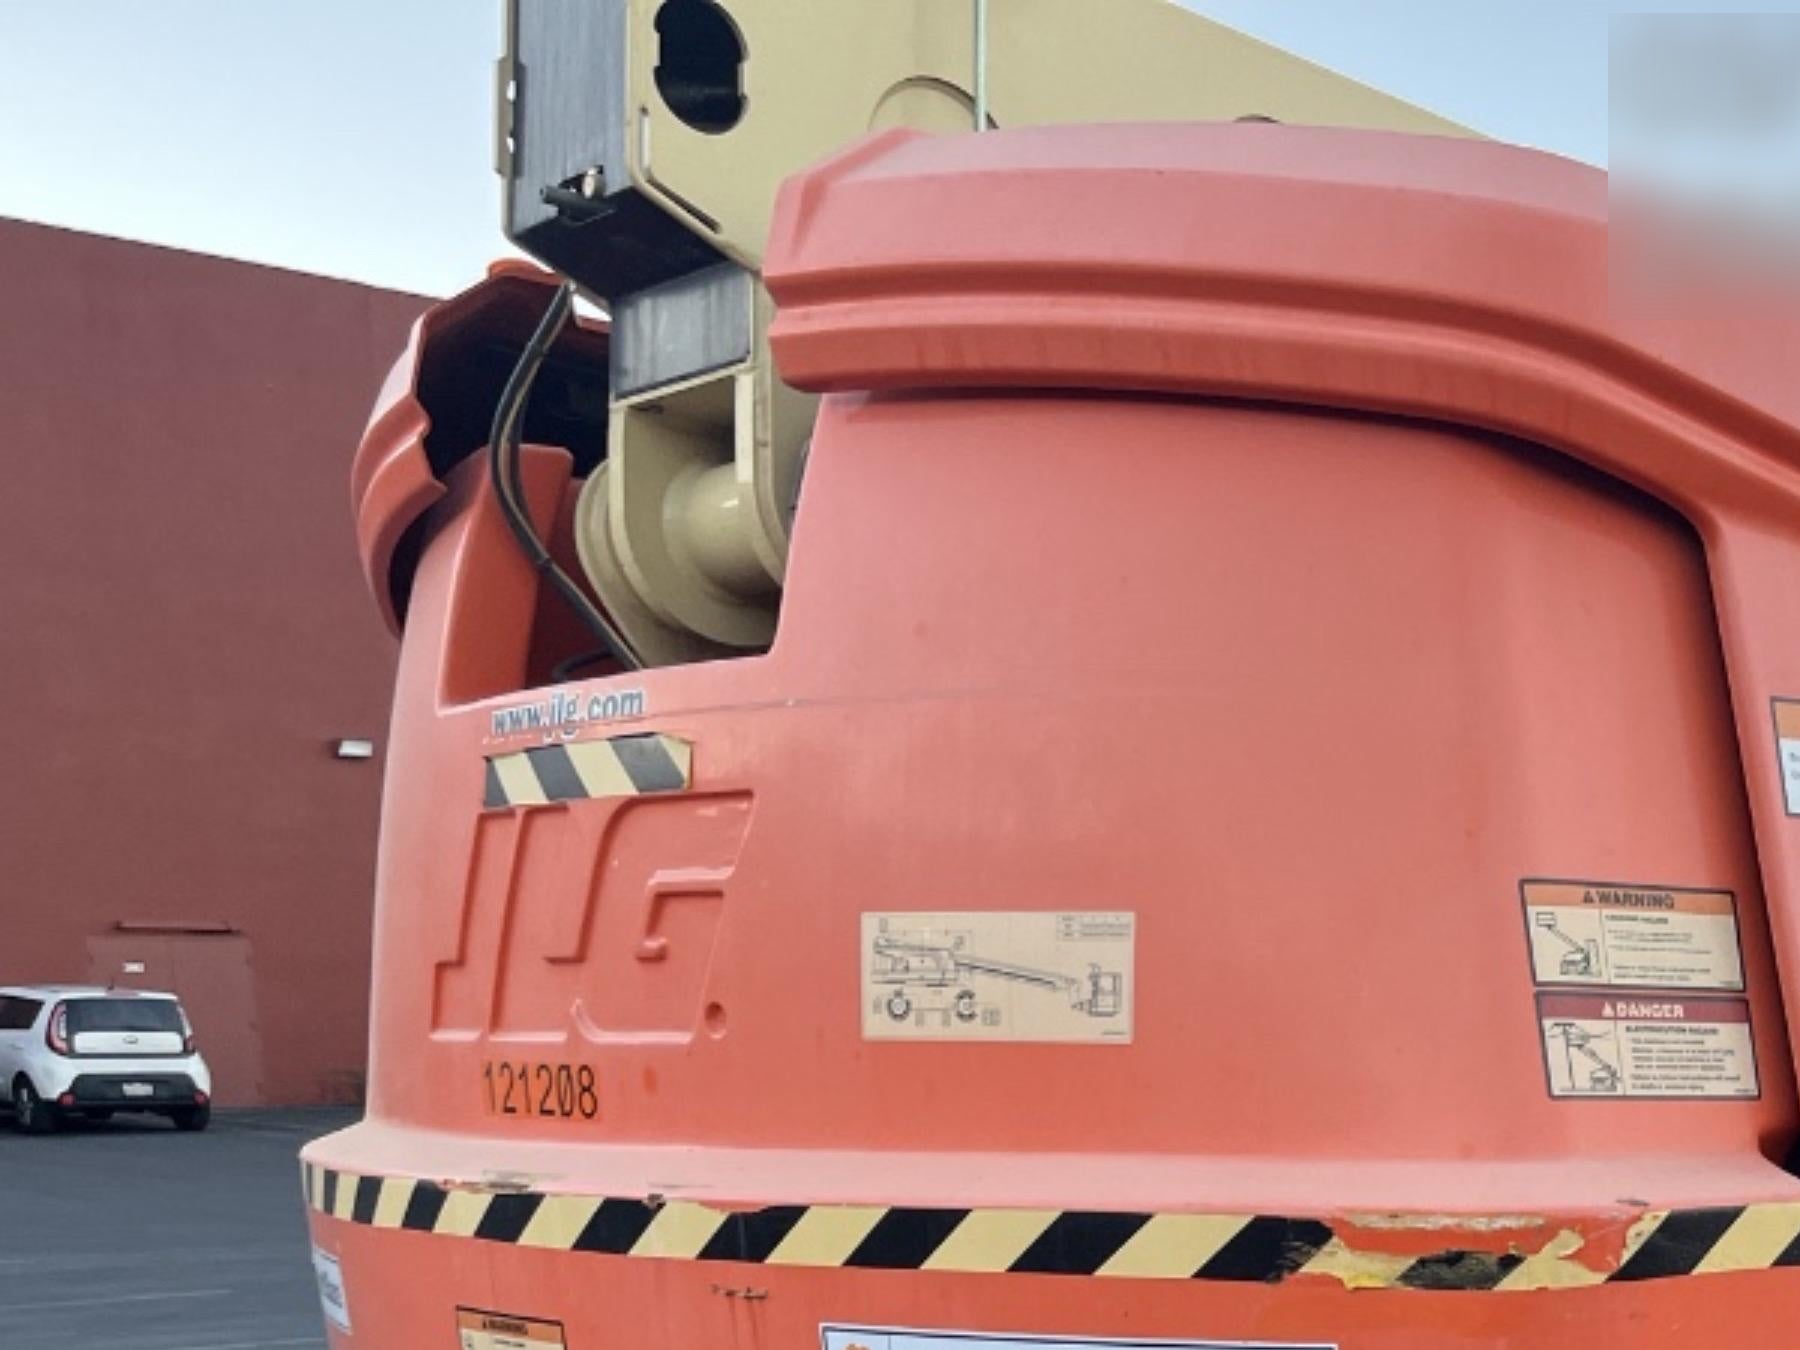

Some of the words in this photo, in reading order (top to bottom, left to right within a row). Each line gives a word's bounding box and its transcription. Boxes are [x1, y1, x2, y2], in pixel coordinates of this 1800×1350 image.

[492, 688, 644, 737] www.jlg.com
[428, 788, 754, 1044] JLG
[1596, 890, 1675, 909] WARNING
[1616, 1003, 1685, 1018] DANGER
[484, 1060, 599, 1120] 121208
